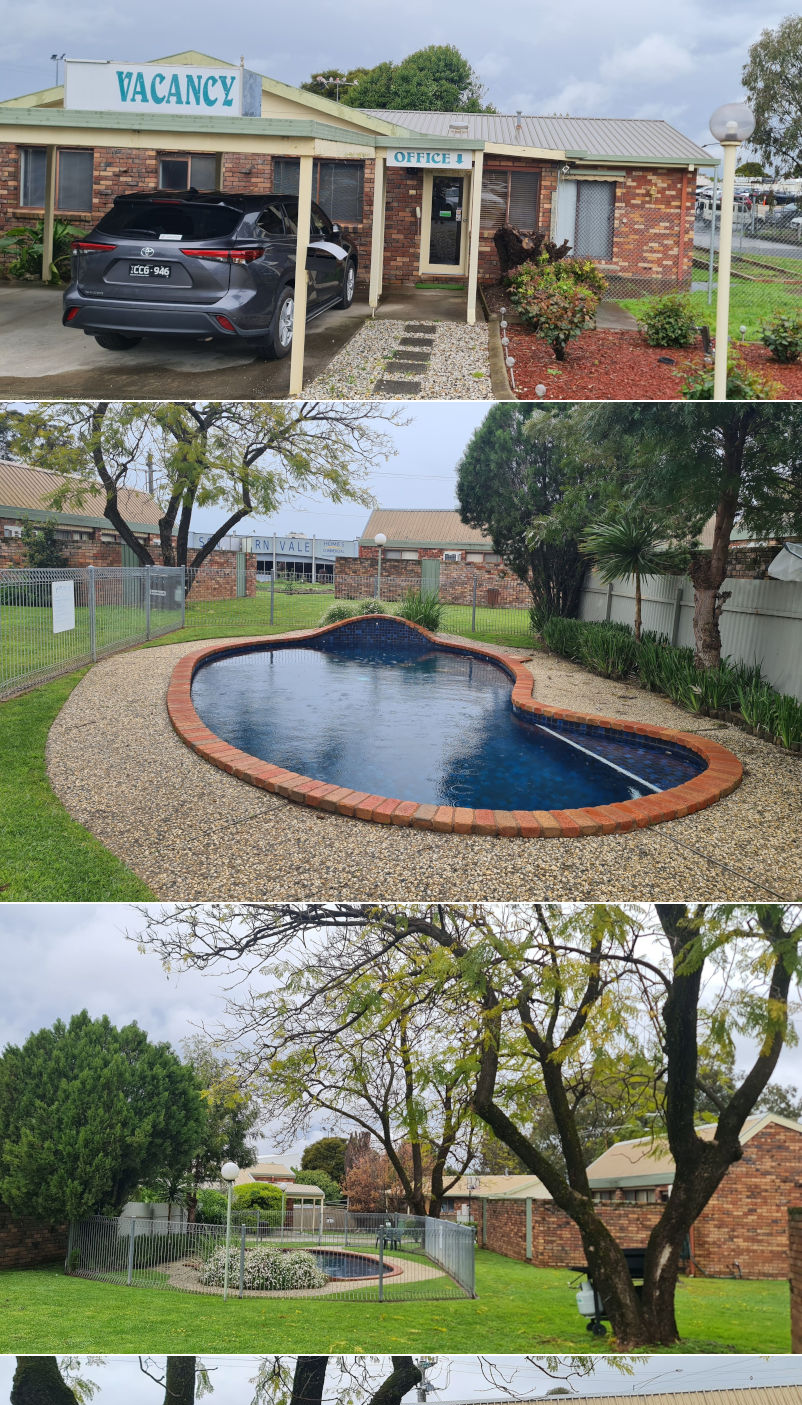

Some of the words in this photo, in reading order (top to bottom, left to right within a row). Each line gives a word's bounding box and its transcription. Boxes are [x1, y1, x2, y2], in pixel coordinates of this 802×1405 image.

[115, 70, 236, 107] VACANCY
[394, 151, 451, 164] OFFICE
[279, 540, 310, 553] VALE
